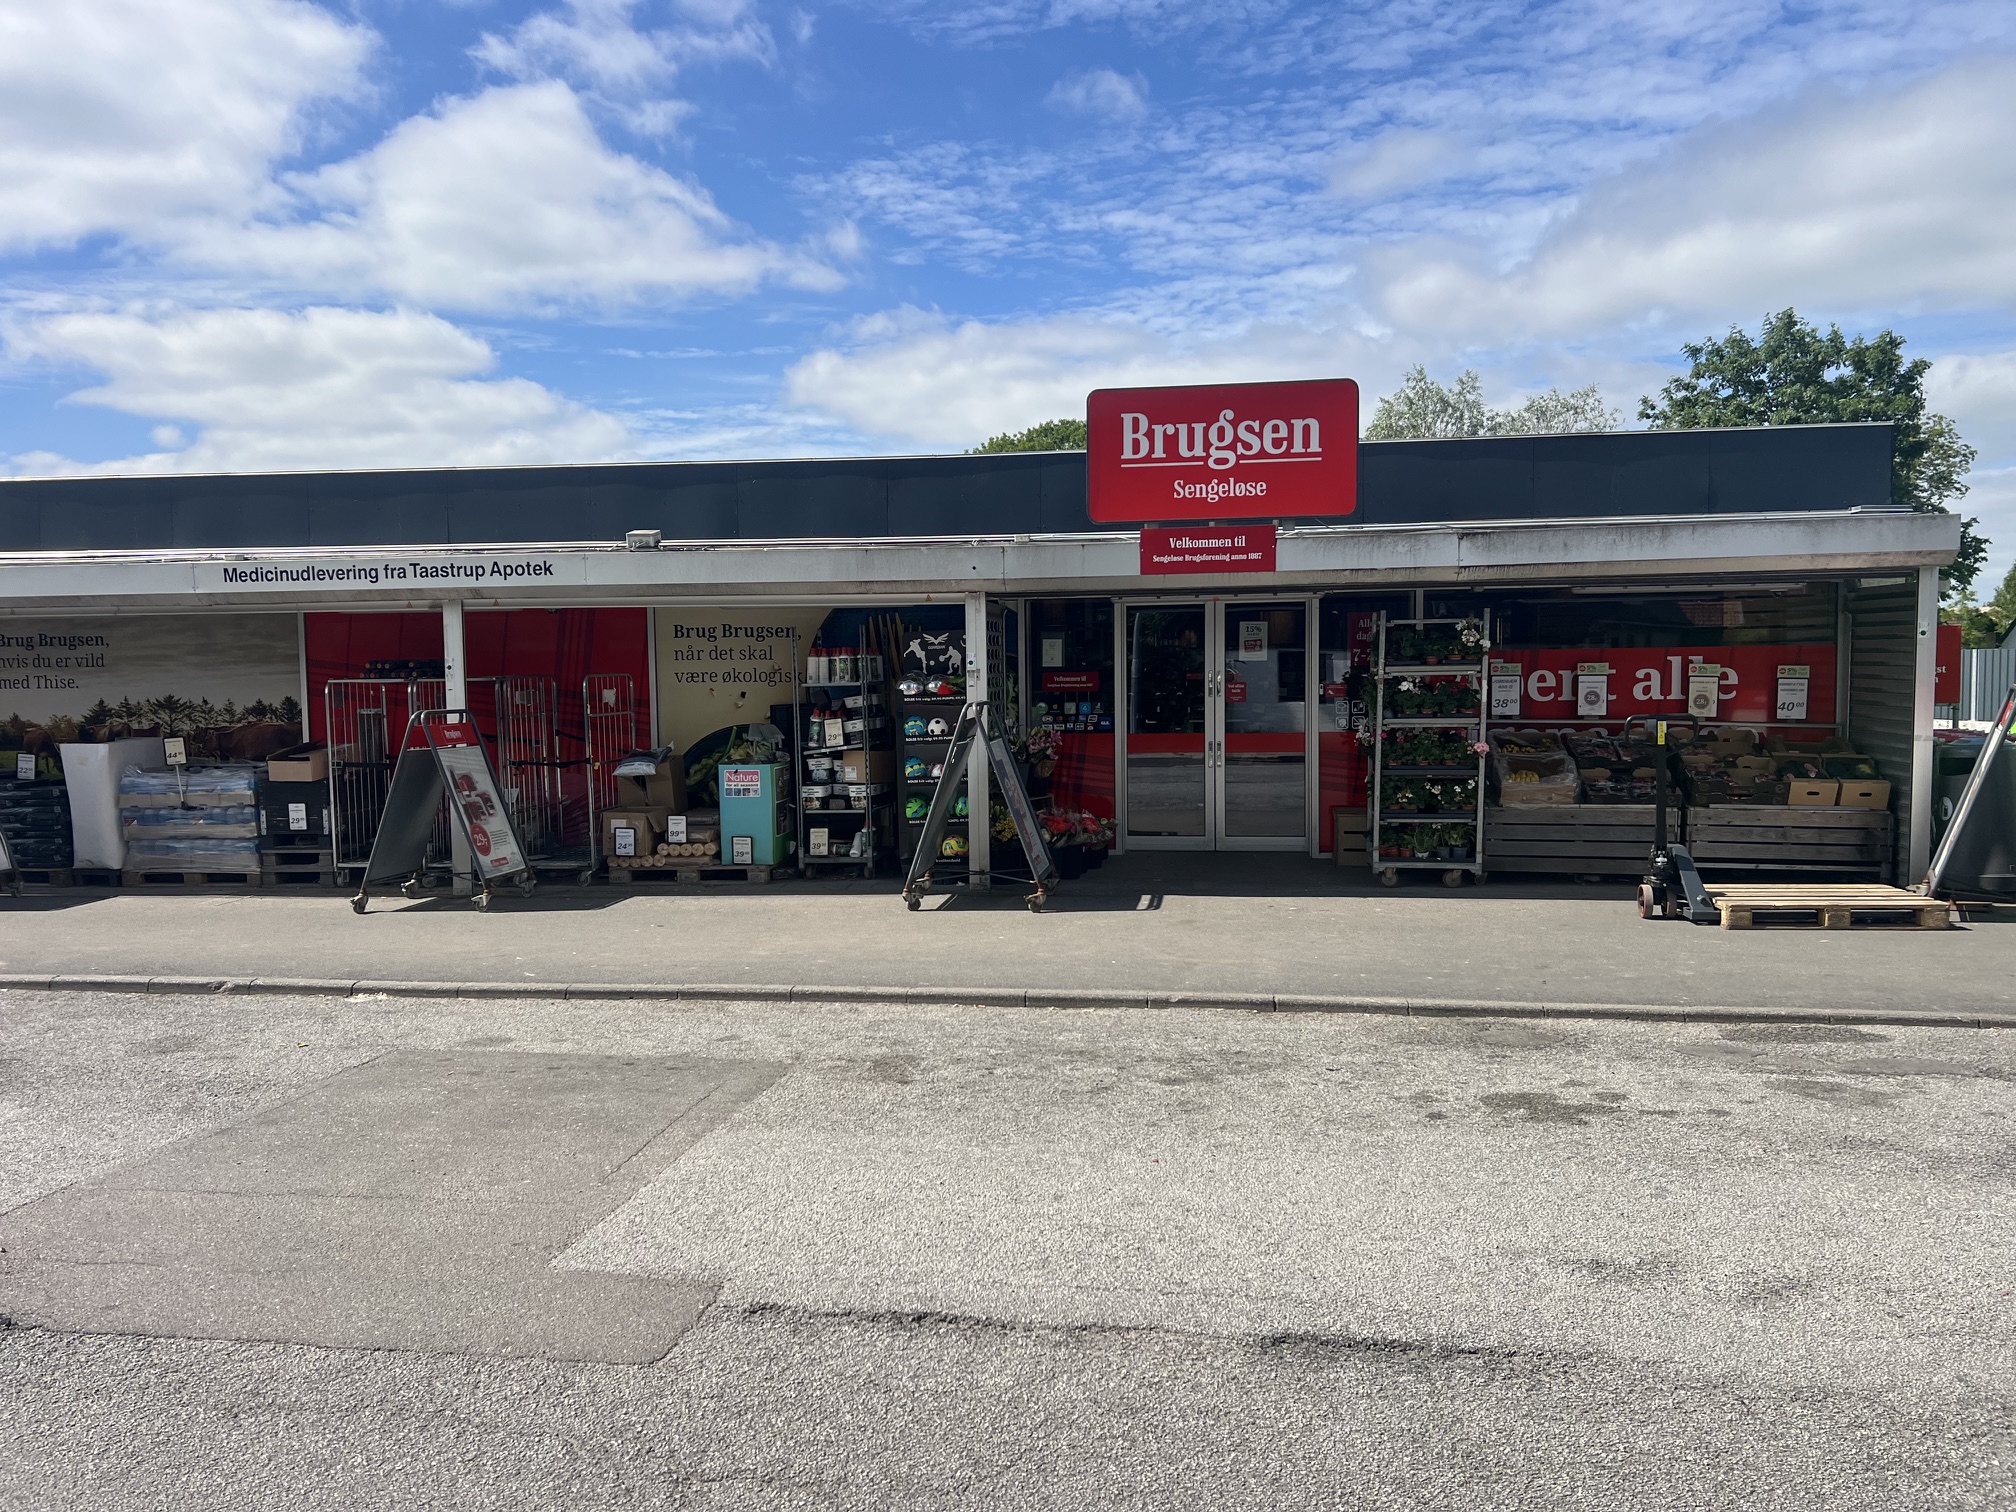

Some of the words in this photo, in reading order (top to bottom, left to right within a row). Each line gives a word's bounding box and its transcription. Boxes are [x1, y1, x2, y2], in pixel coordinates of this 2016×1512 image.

[1120, 408, 1323, 470] Brugsen
[1173, 477, 1268, 503] Sengeløse
[1169, 536, 1233, 549] Velkommen
[1234, 535, 1246, 547] til
[1152, 554, 1184, 564] Sengeløse
[1184, 553, 1231, 563] Brugsforening
[223, 564, 379, 584] Medicinudlevering
[383, 563, 407, 579] fra
[409, 562, 486, 581] Taastrup
[489, 560, 554, 581] Apotek
[673, 624, 718, 642] Brug
[38, 633, 110, 651] Brugsen,
[674, 644, 704, 661] når
[708, 644, 735, 661] det
[739, 644, 774, 661] skal
[32, 653, 52, 668] du
[55, 656, 71, 668] er
[75, 653, 105, 668] vild
[0, 674, 31, 690] med
[33, 674, 79, 689] Thise.
[674, 671, 718, 683] være
[1493, 699, 1509, 709] 38
[1778, 702, 1795, 712] 40
[725, 772, 759, 782] Nature
[811, 842, 821, 850] 39
[735, 850, 745, 858] 39
